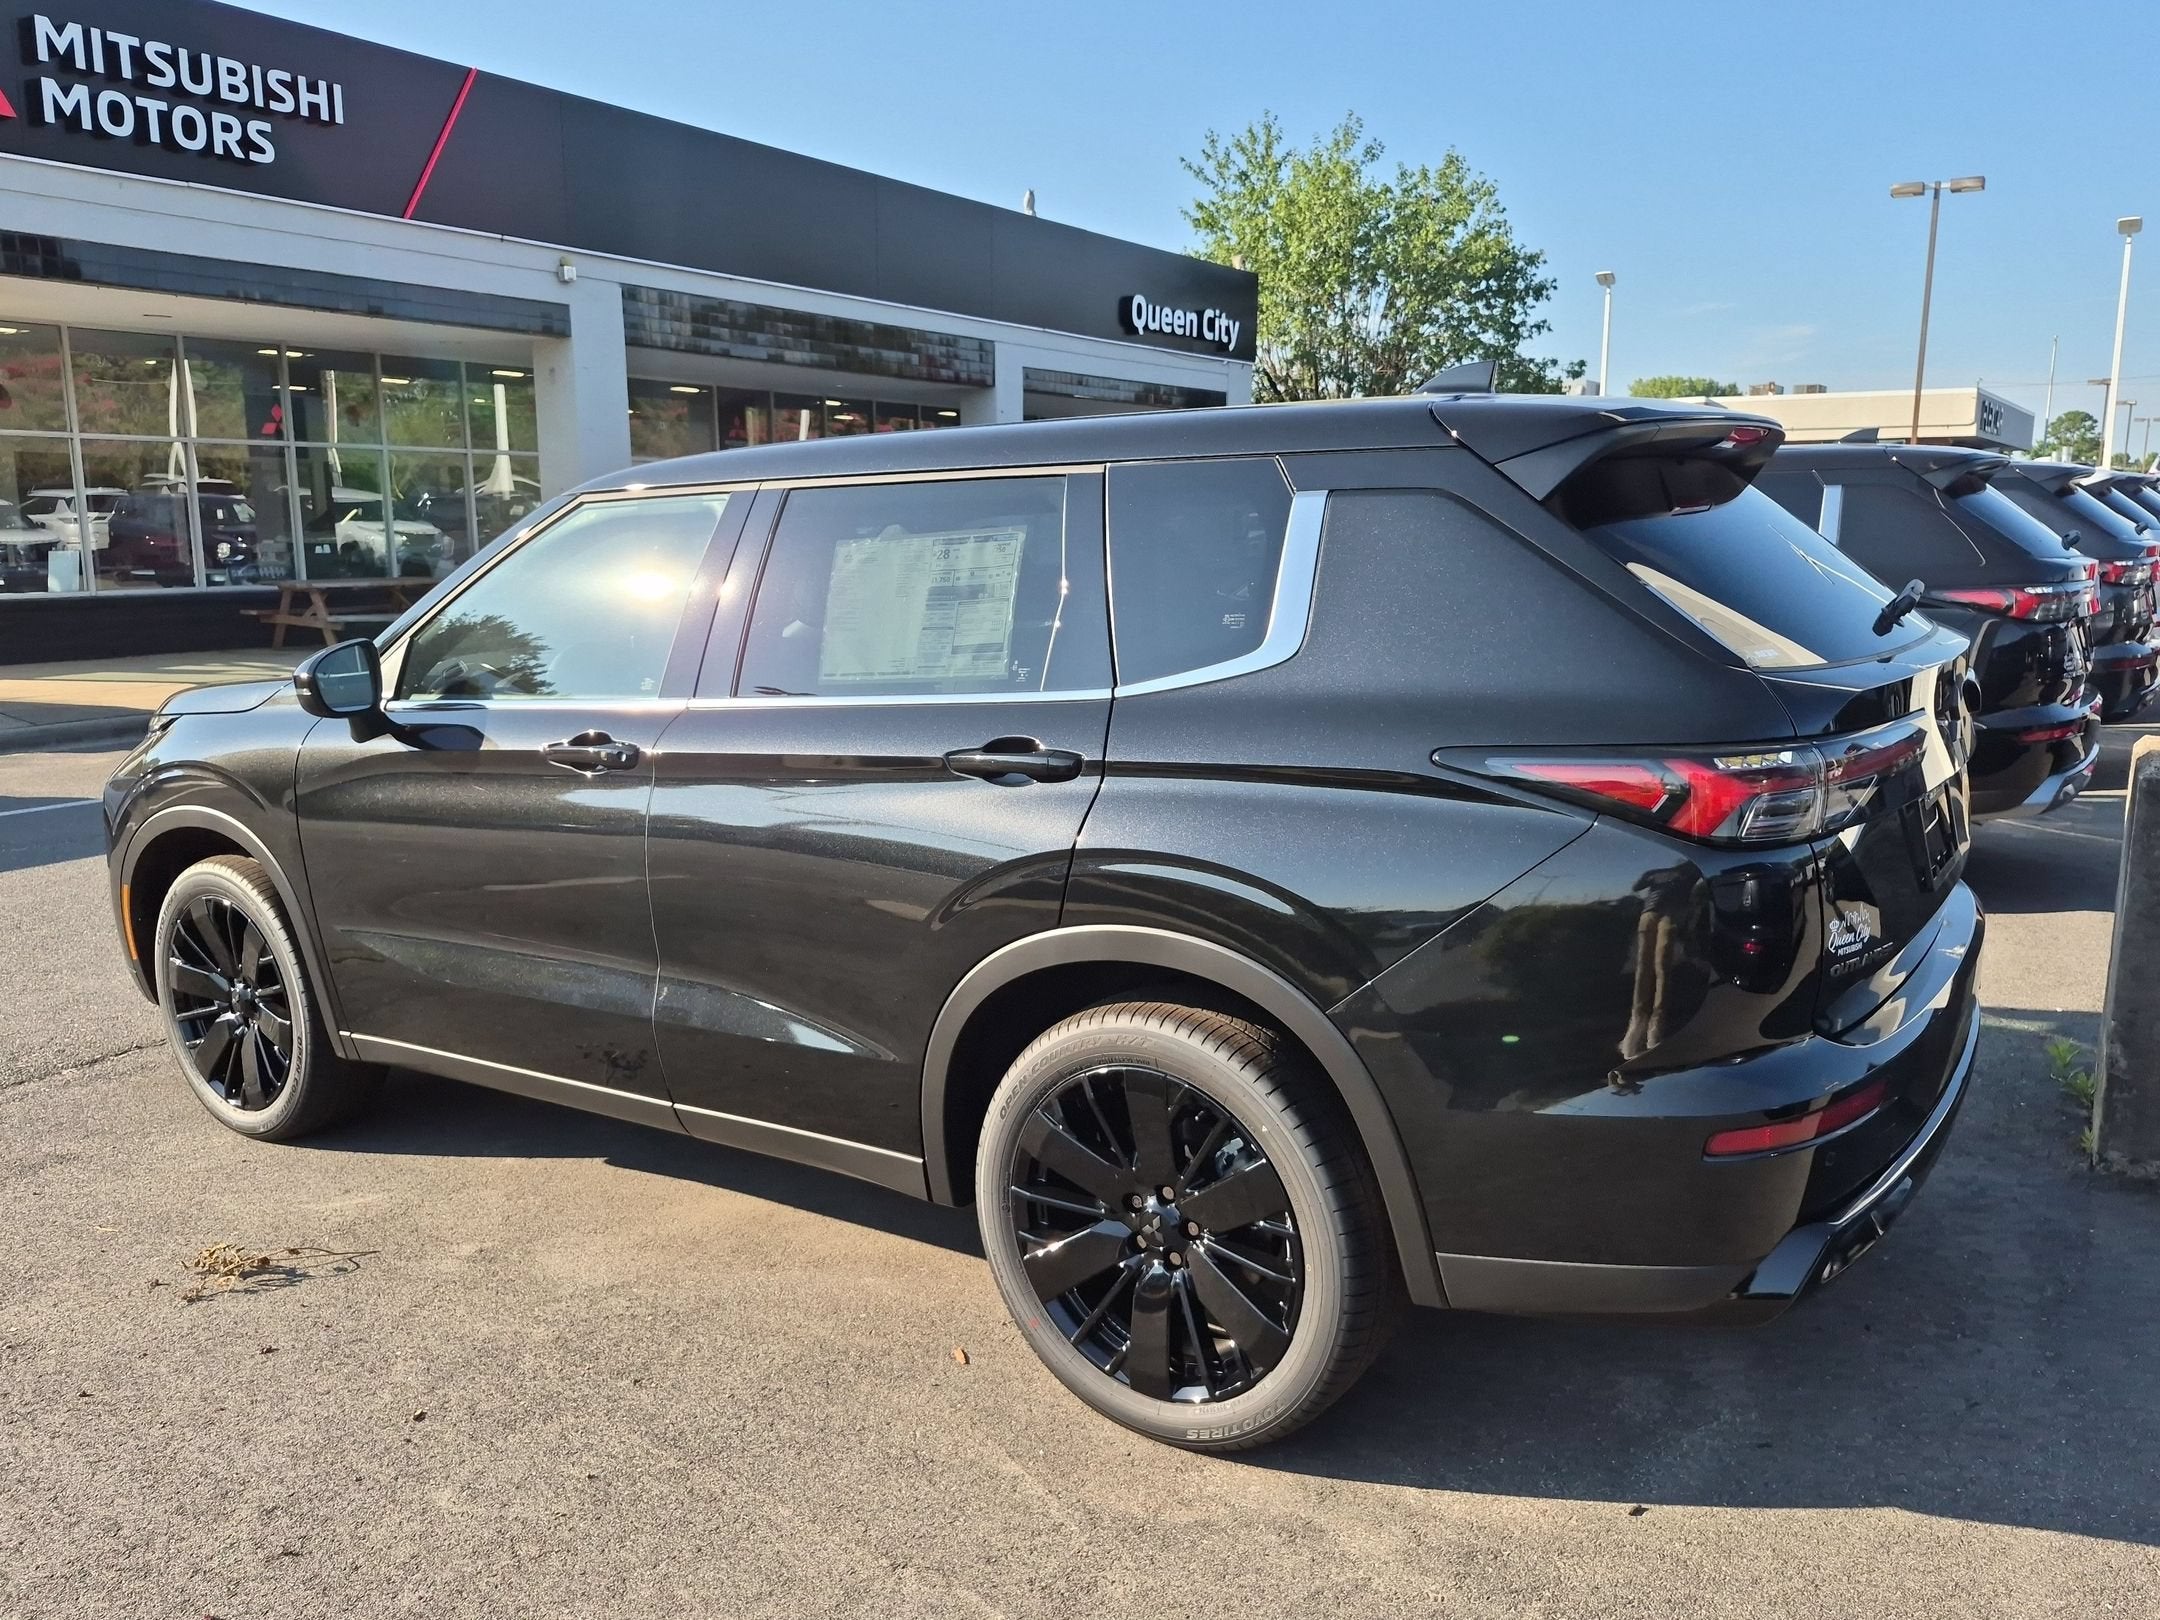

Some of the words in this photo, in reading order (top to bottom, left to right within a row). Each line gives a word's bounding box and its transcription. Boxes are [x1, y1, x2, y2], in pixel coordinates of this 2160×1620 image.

[34, 14, 344, 125] MITSUBISHI
[41, 76, 275, 164] MOTORS
[1131, 294, 1198, 337] Queen
[1202, 308, 1240, 352] City
[937, 549, 951, 560] 28
[1828, 931, 1856, 953] Queen
[1856, 923, 1871, 943] City
[1837, 942, 1863, 957] MITSUBISHI
[295, 1036, 303, 1074] OPEN
[1000, 1074, 1031, 1121] OPEN
[1030, 1034, 1101, 1074] COUNTRY
[1242, 1398, 1286, 1431] TOYO
[1186, 1425, 1241, 1440] TIRES
